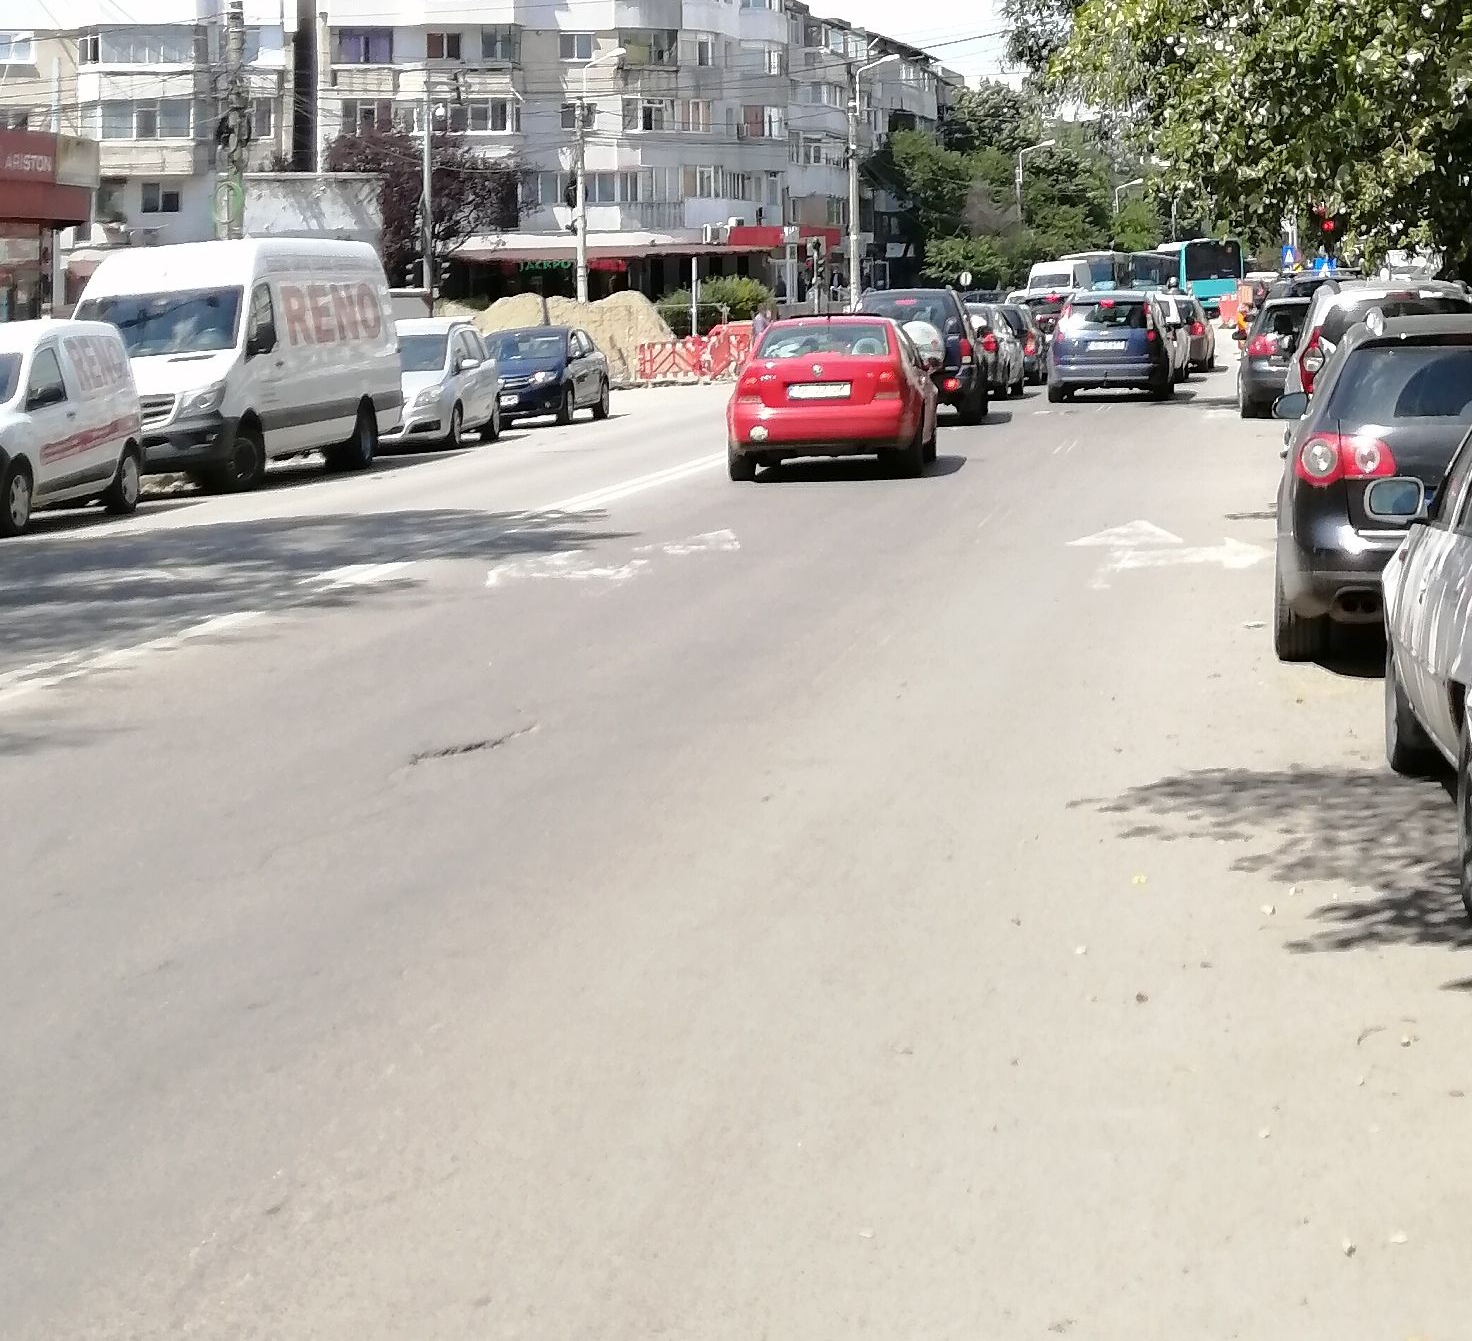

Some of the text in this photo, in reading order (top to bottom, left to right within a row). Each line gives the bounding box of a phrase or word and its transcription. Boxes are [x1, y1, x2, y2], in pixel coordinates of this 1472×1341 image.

[4, 153, 52, 172] ARISTON
[519, 259, 575, 272] JACKPO
[281, 283, 381, 346] RENO
